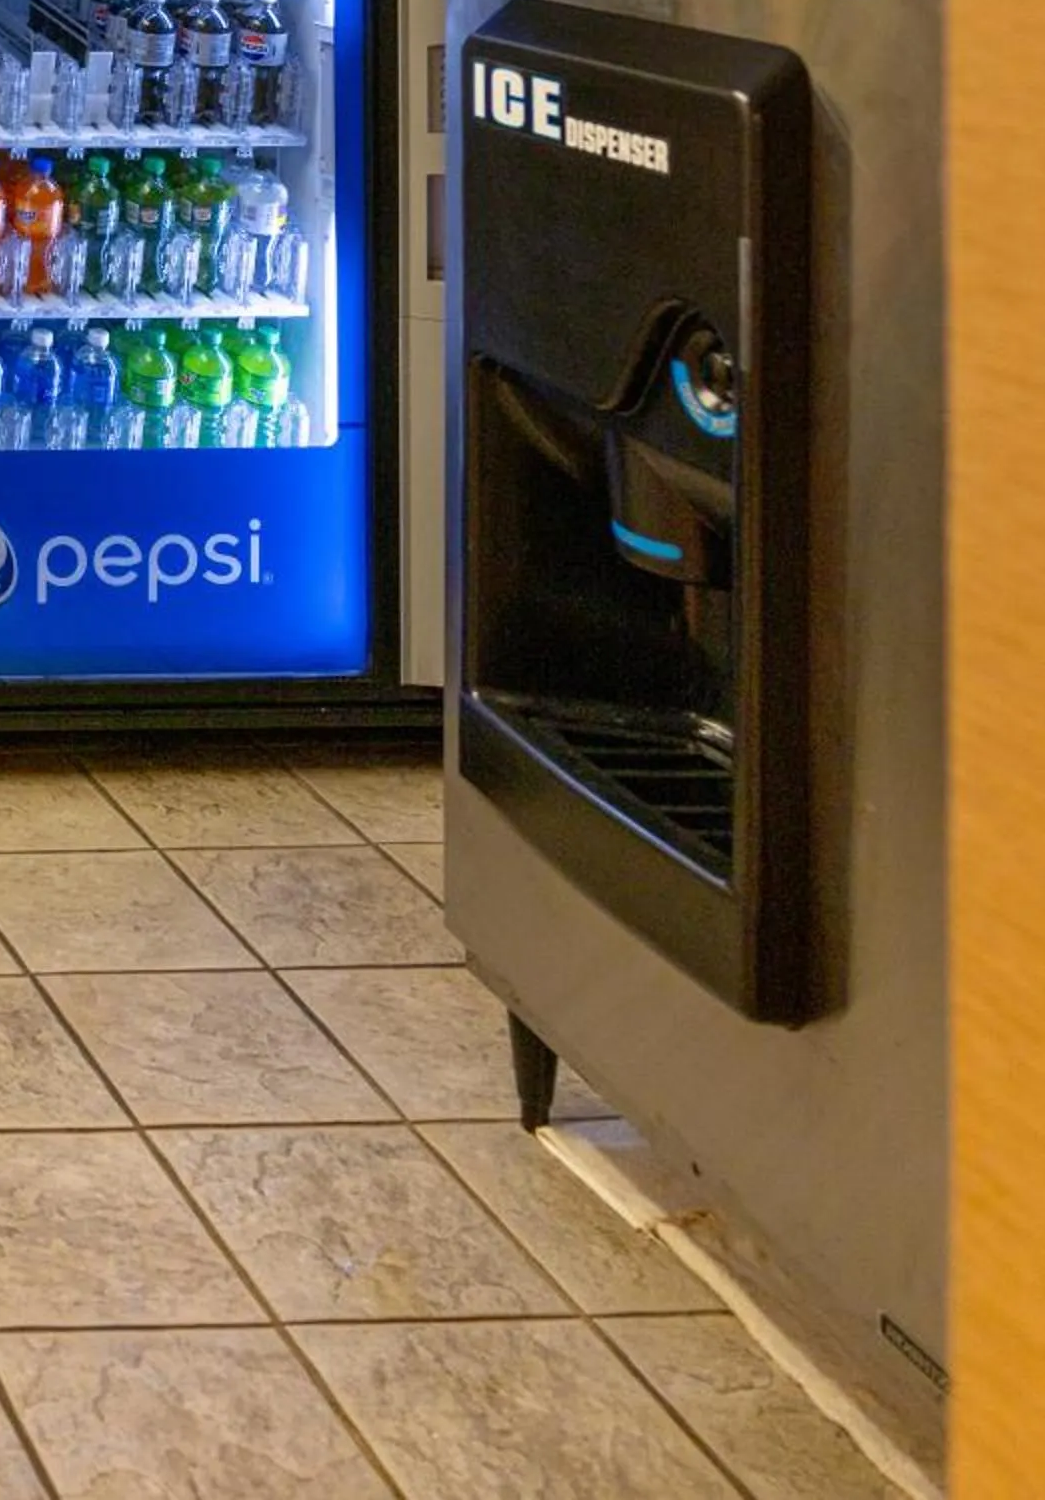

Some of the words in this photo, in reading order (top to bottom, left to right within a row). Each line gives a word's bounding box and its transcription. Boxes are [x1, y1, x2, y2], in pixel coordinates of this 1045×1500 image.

[473, 62, 561, 140] ICE
[564, 115, 669, 174] DISPENSER
[36, 517, 262, 605] pepsi
